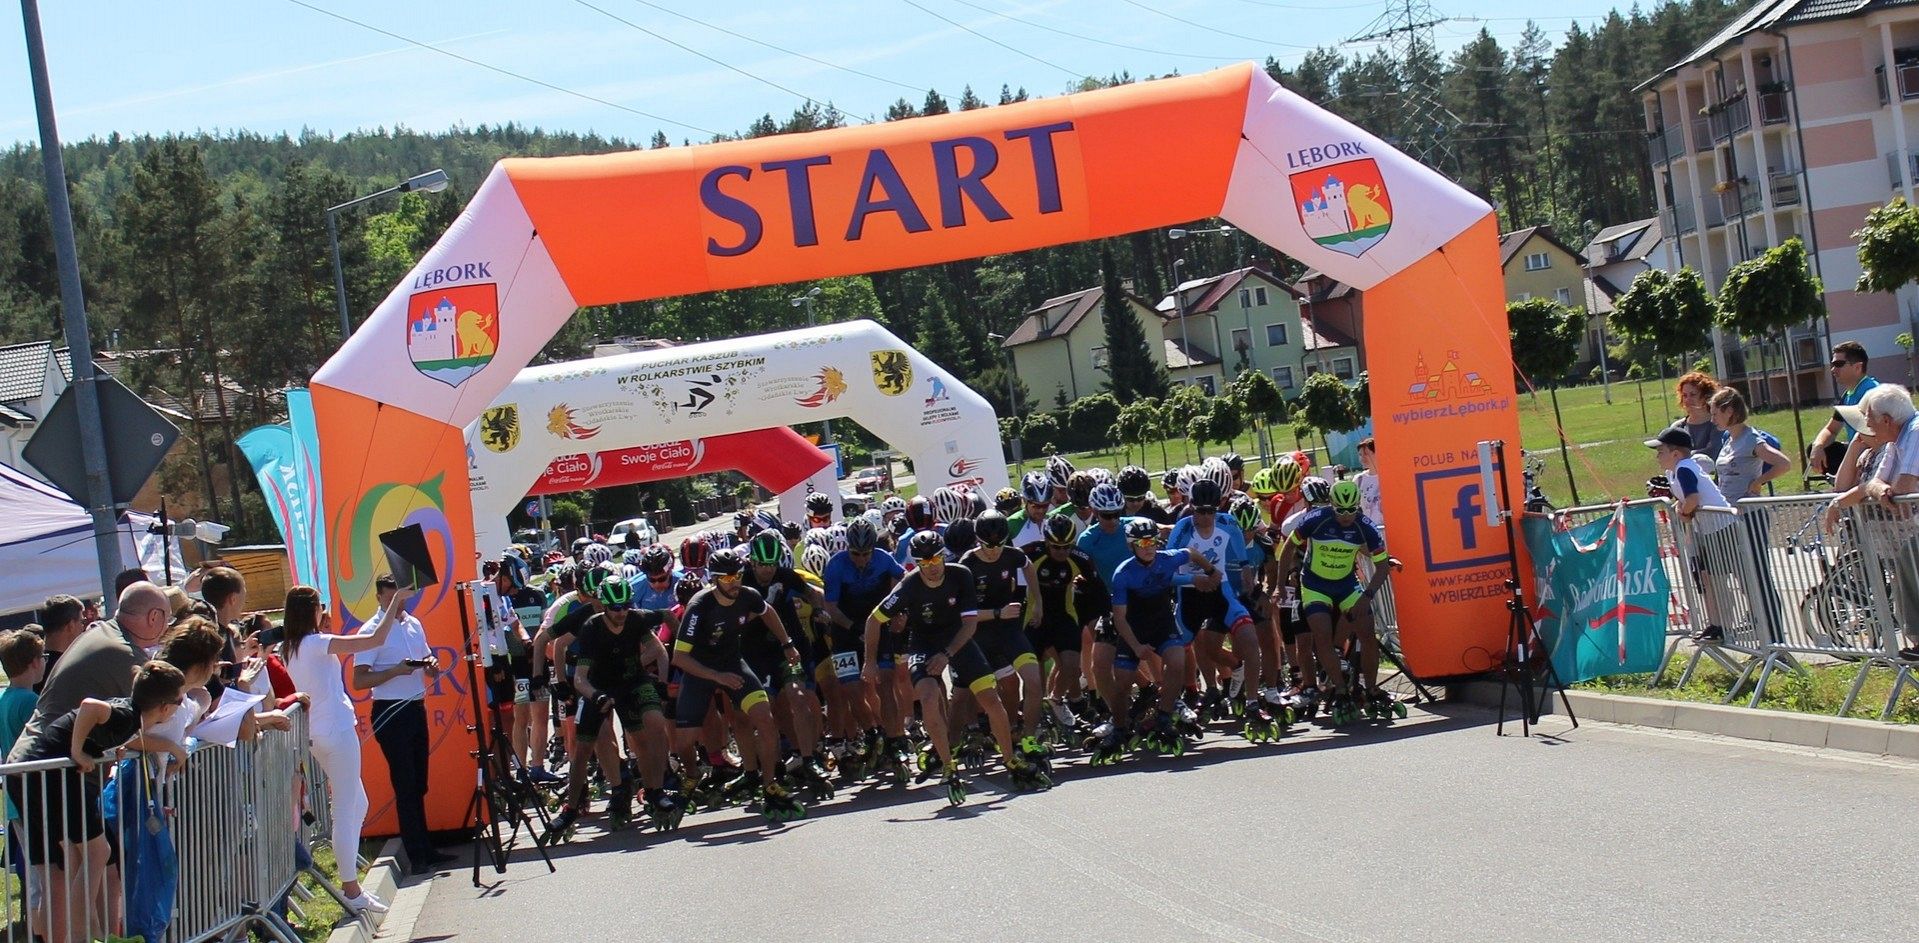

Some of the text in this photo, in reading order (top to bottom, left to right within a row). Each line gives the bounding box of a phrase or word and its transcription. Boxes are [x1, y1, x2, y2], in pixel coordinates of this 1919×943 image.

[1286, 141, 1367, 168] LĘBORK
[700, 121, 1074, 257] START
[414, 262, 491, 289] LĘBORK
[617, 357, 765, 385] W ROLKARSTWIE SZYBKIM
[641, 351, 738, 370] PUCHAR KASZUB
[557, 461, 588, 473] Ciało
[621, 446, 690, 465] Swoje Ciało
[1413, 452, 1455, 467] POLUB
[687, 614, 699, 637] uvex
